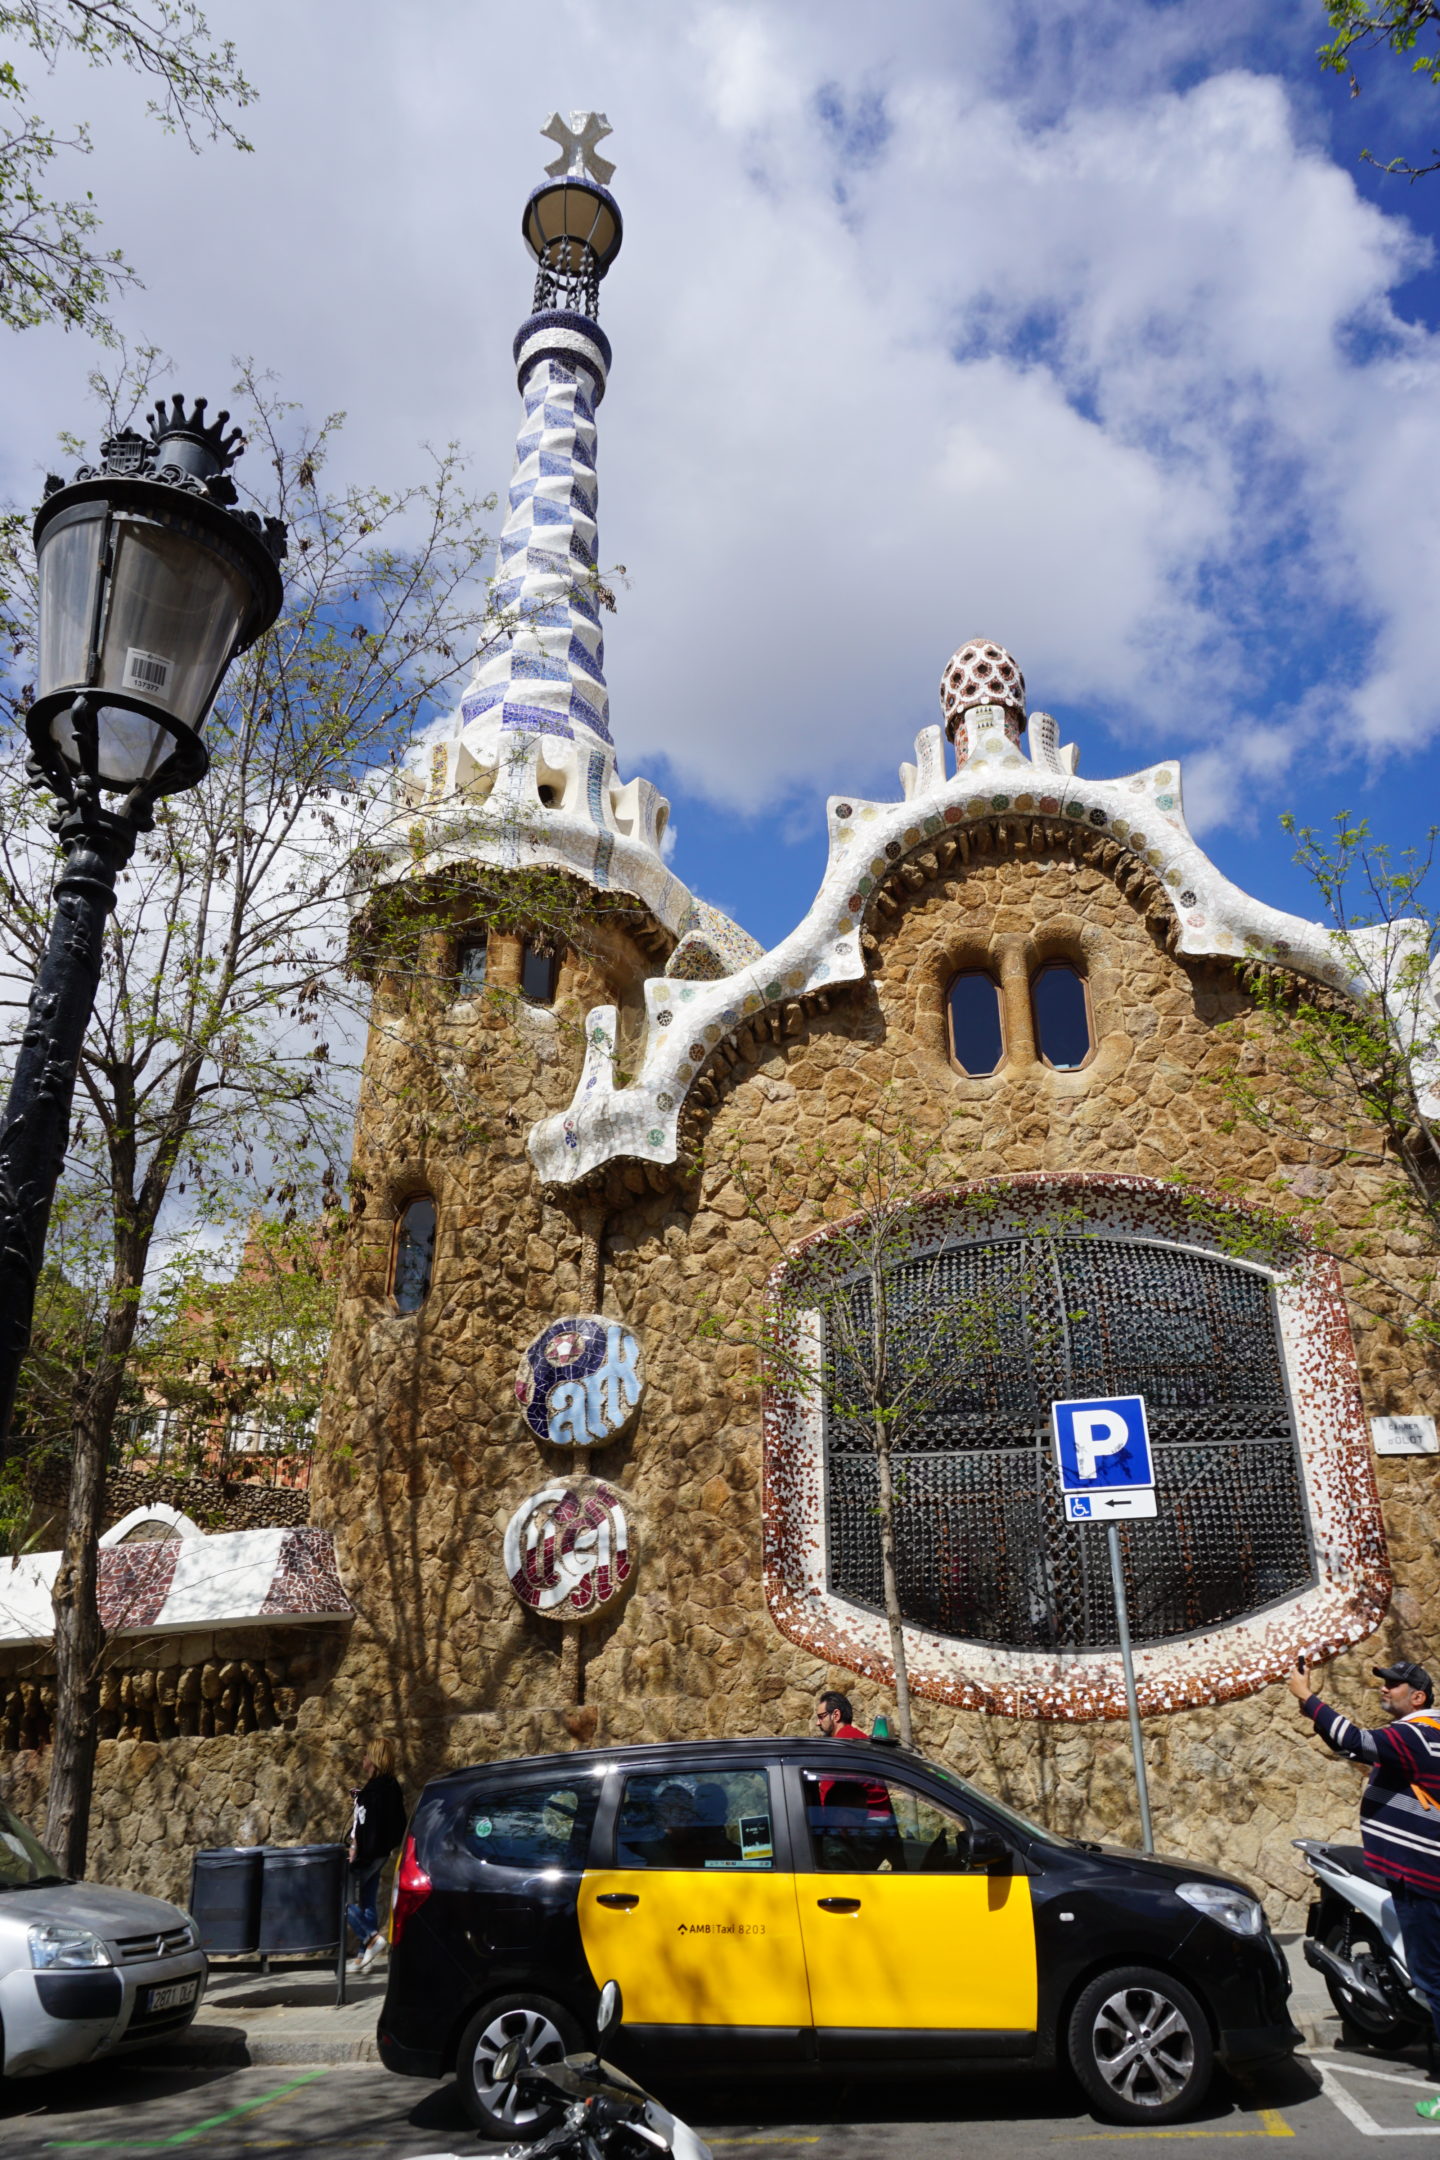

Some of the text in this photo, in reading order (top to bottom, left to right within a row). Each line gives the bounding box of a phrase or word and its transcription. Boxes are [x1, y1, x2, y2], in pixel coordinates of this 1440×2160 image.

[527, 1318, 643, 1445] Park
[1072, 1409, 1129, 1480] P
[689, 1924, 766, 1935] AMB Taxi 8203
